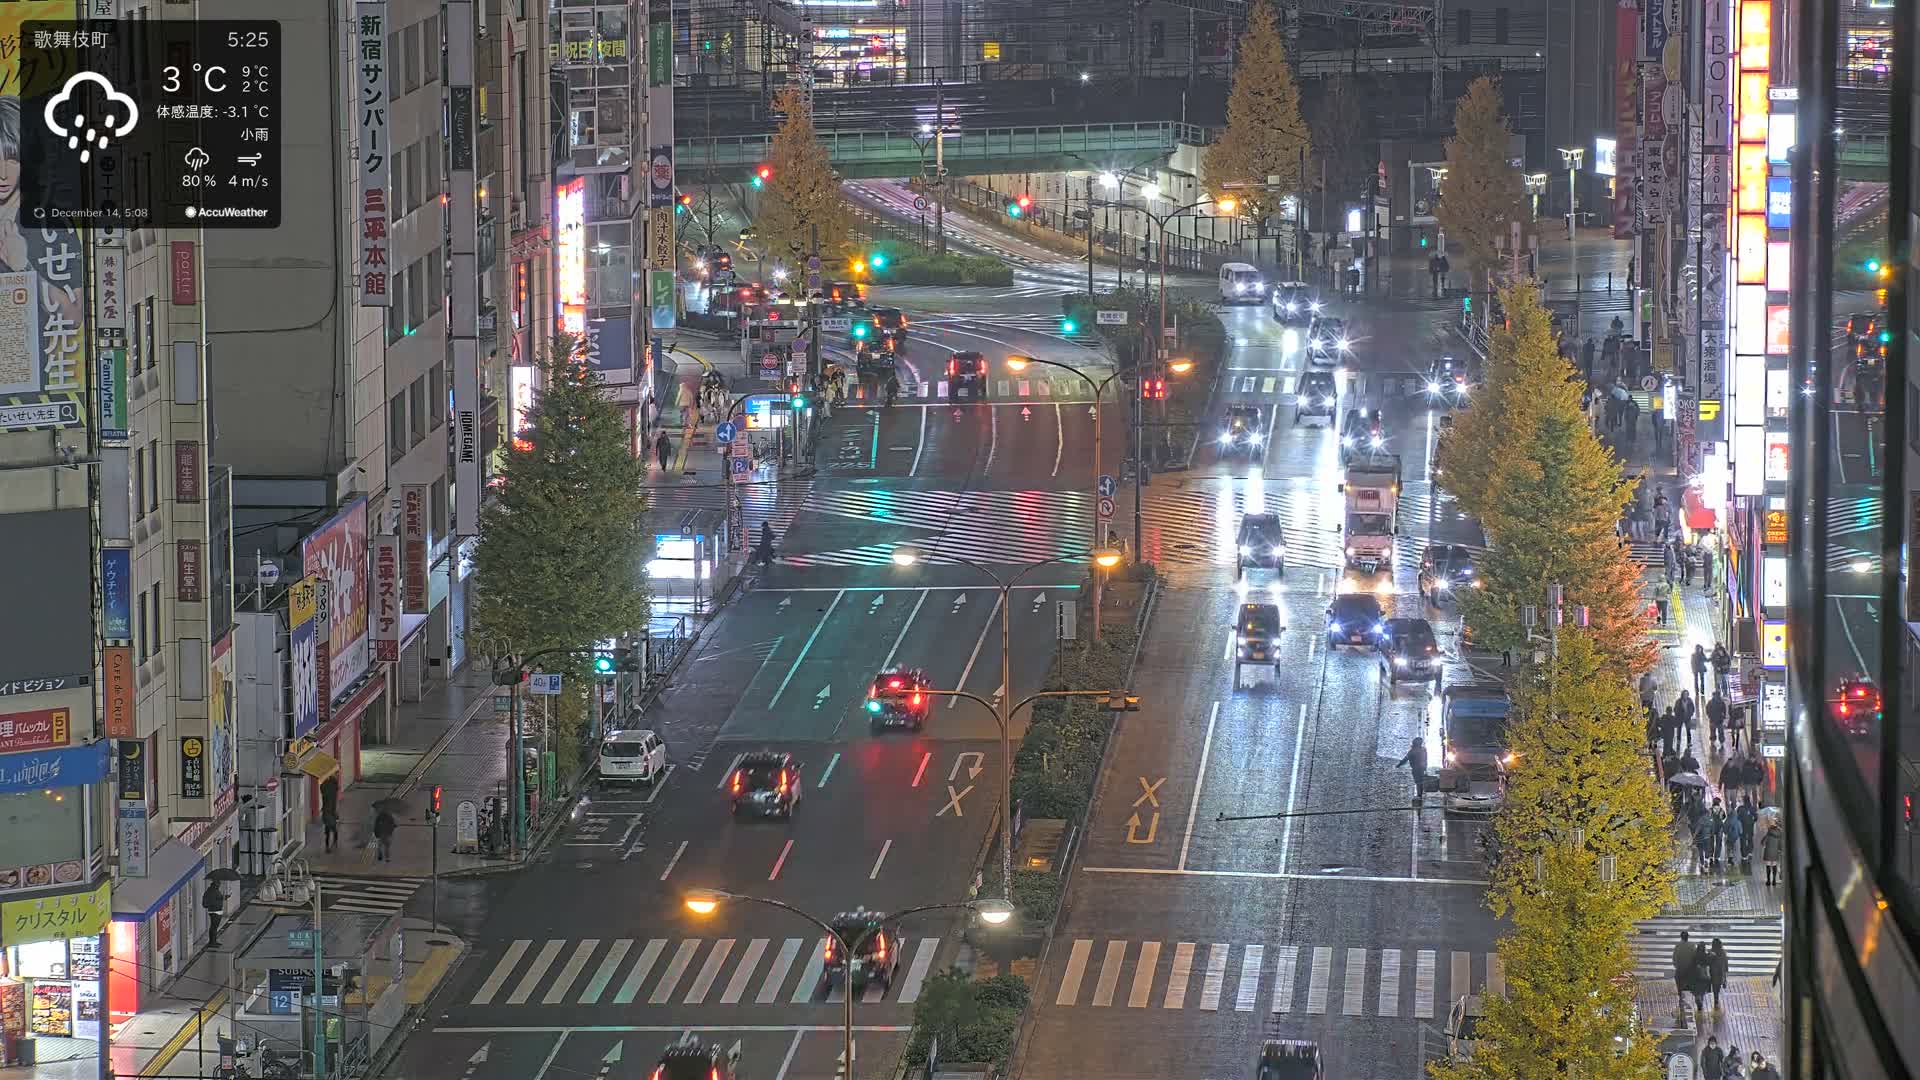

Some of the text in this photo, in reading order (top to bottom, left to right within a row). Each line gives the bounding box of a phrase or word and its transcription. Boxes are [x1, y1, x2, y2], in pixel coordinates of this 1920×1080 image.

[361, 15, 387, 295] 新宿サンパーク 三平本館
[104, 329, 120, 337] 3F
[1703, 333, 1717, 385] 大衆酒場
[103, 357, 114, 419] FamilyMart
[460, 411, 473, 463] HOMEGAME
[378, 546, 394, 633] 三平ストア
[113, 654, 122, 724] CAFE de CRIE
[55, 715, 64, 739] 5F
[16, 908, 87, 931] クリスタル
[272, 995, 288, 1008] 12
